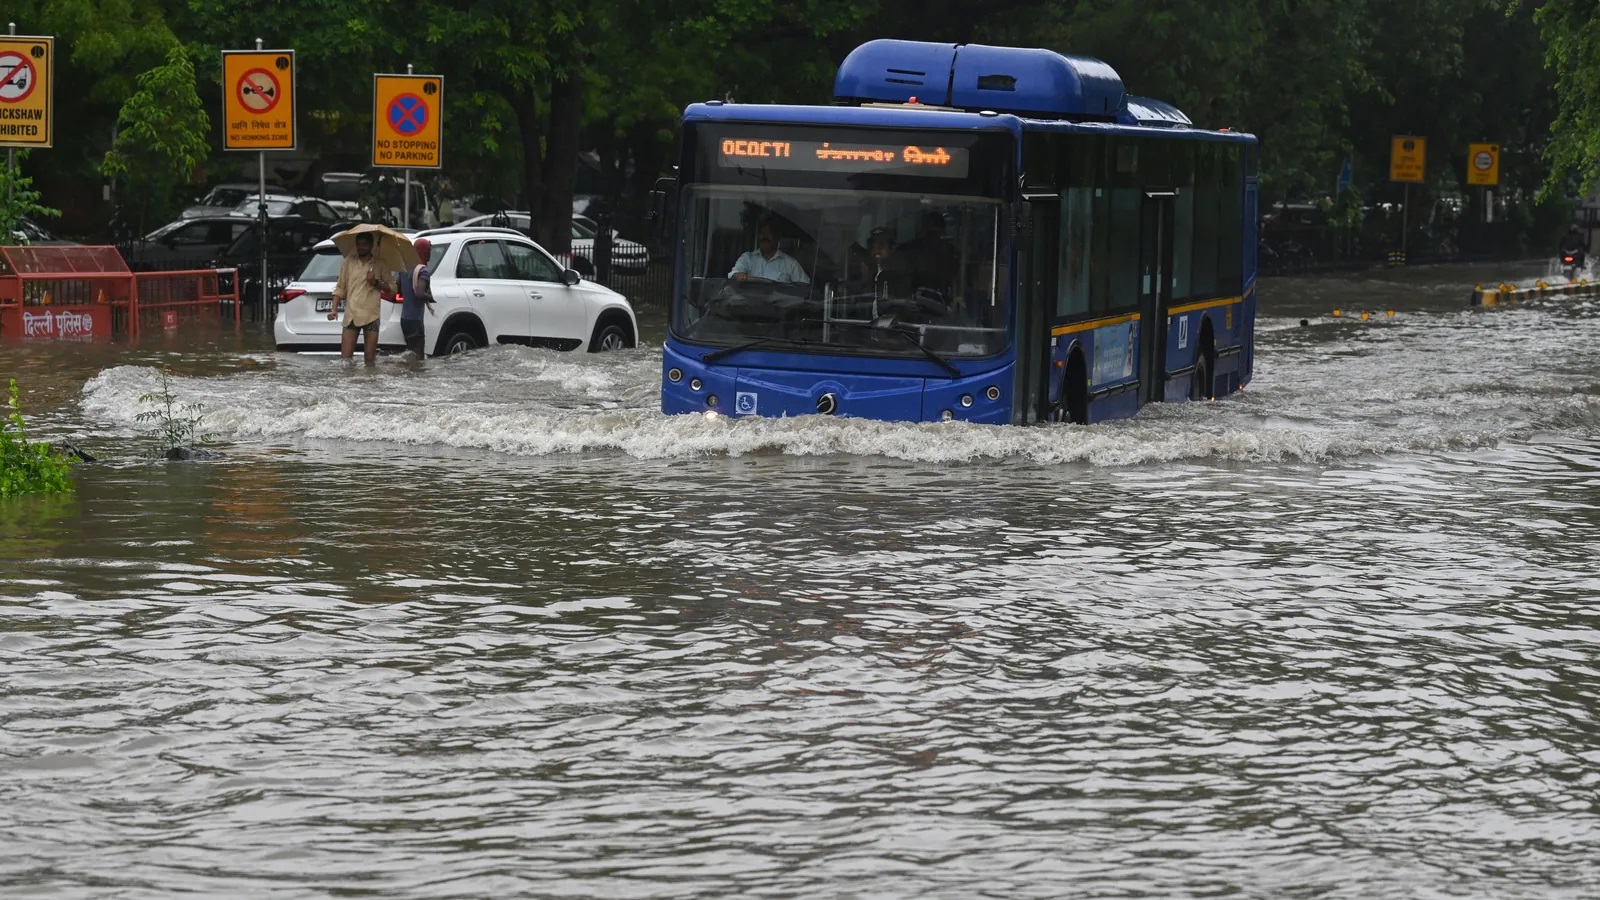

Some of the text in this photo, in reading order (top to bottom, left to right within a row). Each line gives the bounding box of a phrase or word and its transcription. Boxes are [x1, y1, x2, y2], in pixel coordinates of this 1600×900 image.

[0, 124, 38, 136] HIBITED
[377, 140, 437, 150] NO STOPPING
[380, 151, 434, 160] NO PARKING
[23, 310, 82, 336] दिल्ली पुलिस
